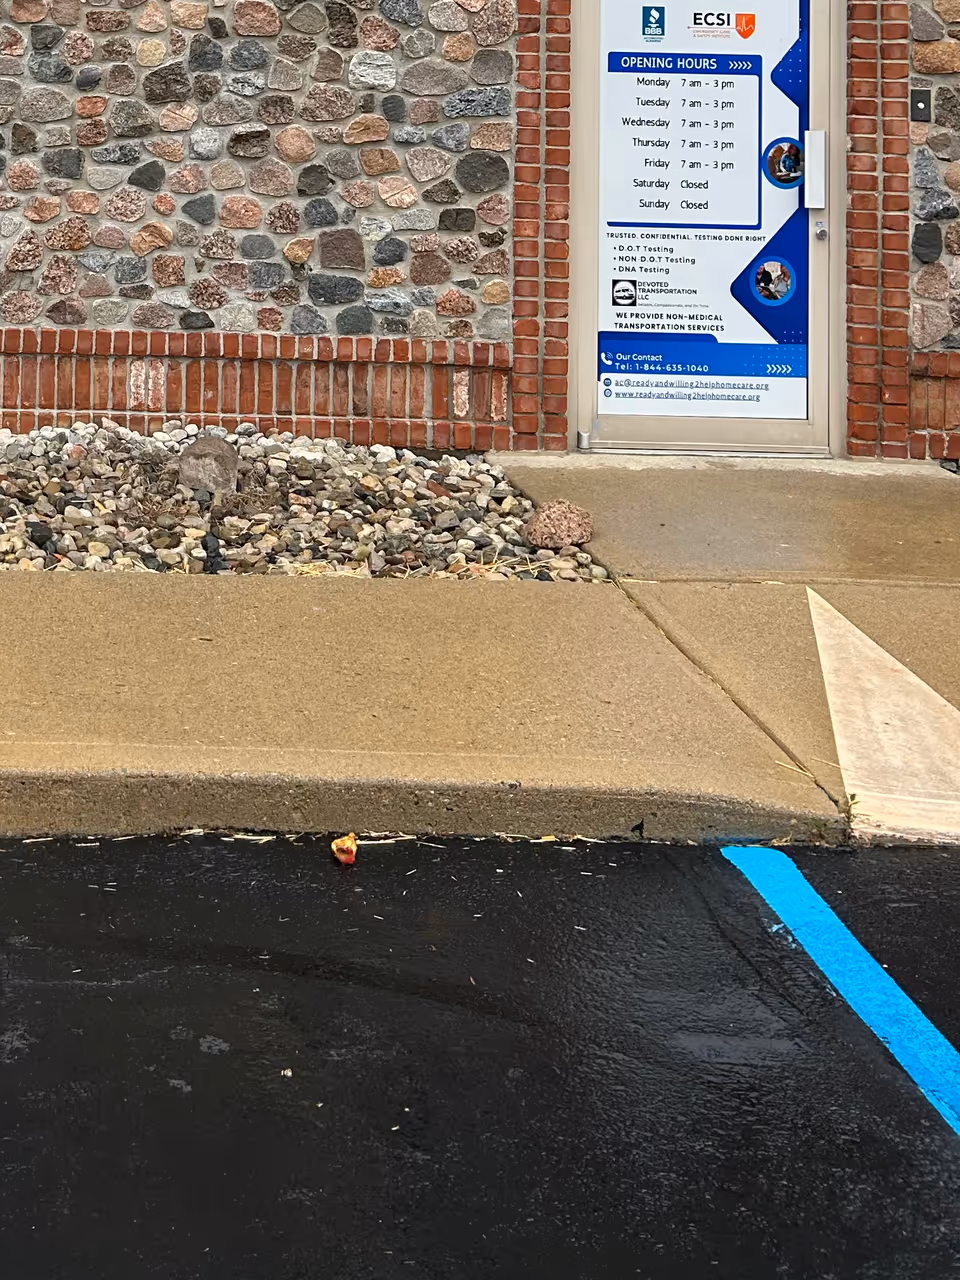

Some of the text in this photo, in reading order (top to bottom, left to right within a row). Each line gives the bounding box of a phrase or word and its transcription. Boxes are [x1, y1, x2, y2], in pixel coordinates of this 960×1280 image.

[693, 12, 731, 26] ECSI
[644, 27, 662, 35] BBB
[621, 56, 717, 70] OPENING HOURS
[636, 77, 671, 89] Monday
[681, 79, 686, 88] 7
[713, 79, 719, 88] 3
[721, 81, 735, 90] pm
[636, 97, 671, 109] Tuesday
[681, 99, 686, 108] 7
[713, 99, 719, 108] 3
[721, 101, 735, 110] pm
[621, 117, 671, 129] Wednesday
[681, 119, 686, 128] 7
[713, 119, 719, 128] 3
[721, 121, 735, 130] pm
[632, 137, 671, 150] Thursday
[681, 140, 686, 149] 7
[713, 140, 719, 149] 3
[721, 142, 735, 151] pm
[644, 158, 671, 170] Friday
[681, 160, 686, 169] 7
[713, 160, 719, 169] 3
[721, 162, 735, 171] pm
[633, 178, 709, 190] Saturday Closed
[639, 199, 709, 211] Sunday Closed
[643, 245, 674, 254] Testing
[665, 256, 696, 265] Testing
[618, 265, 670, 275] DNA Testing
[630, 312, 664, 320] PROVIDE
[666, 313, 723, 321] NON-MEDICAL
[614, 322, 685, 330] TRANSPORTATION
[632, 353, 663, 362] Contact
[615, 362, 709, 373] Tel: 1-844-635-1040
